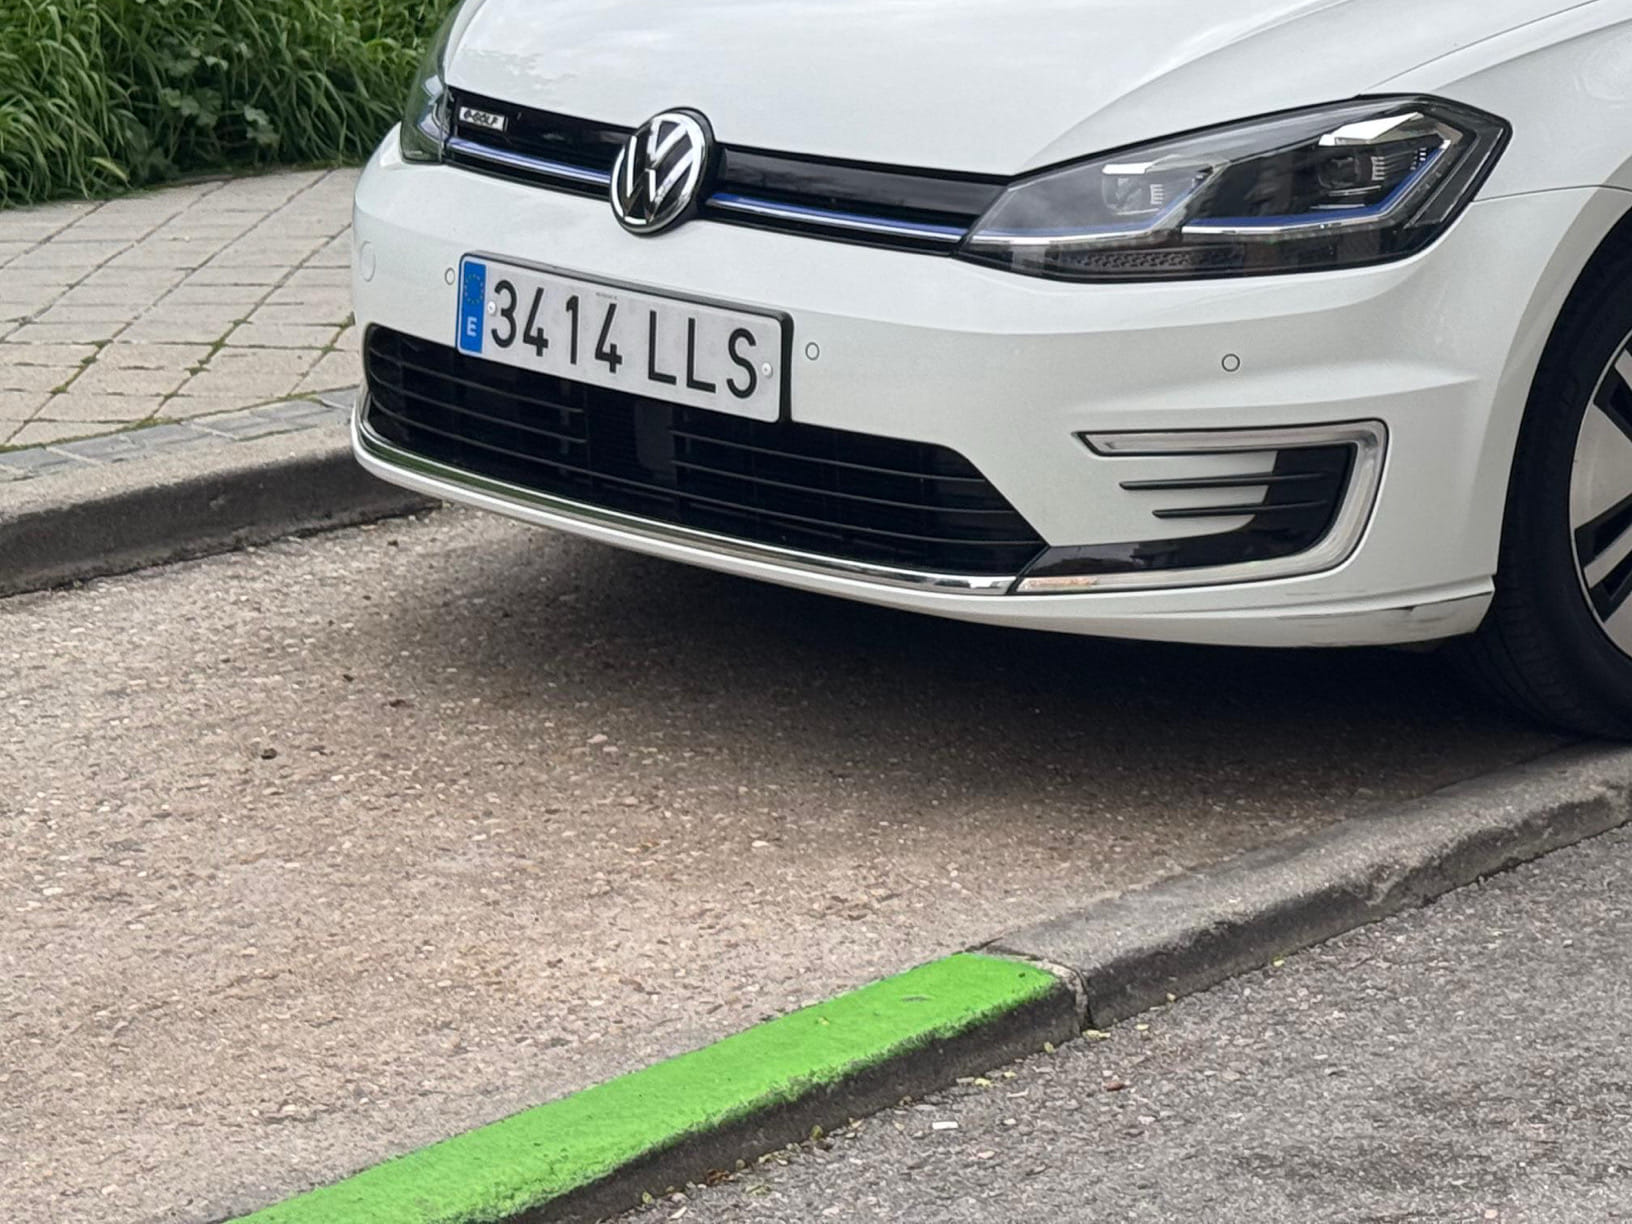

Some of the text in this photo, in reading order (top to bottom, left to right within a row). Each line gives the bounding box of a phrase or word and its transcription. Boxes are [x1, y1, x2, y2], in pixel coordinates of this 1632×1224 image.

[466, 279, 757, 399] E 3414 LLS
